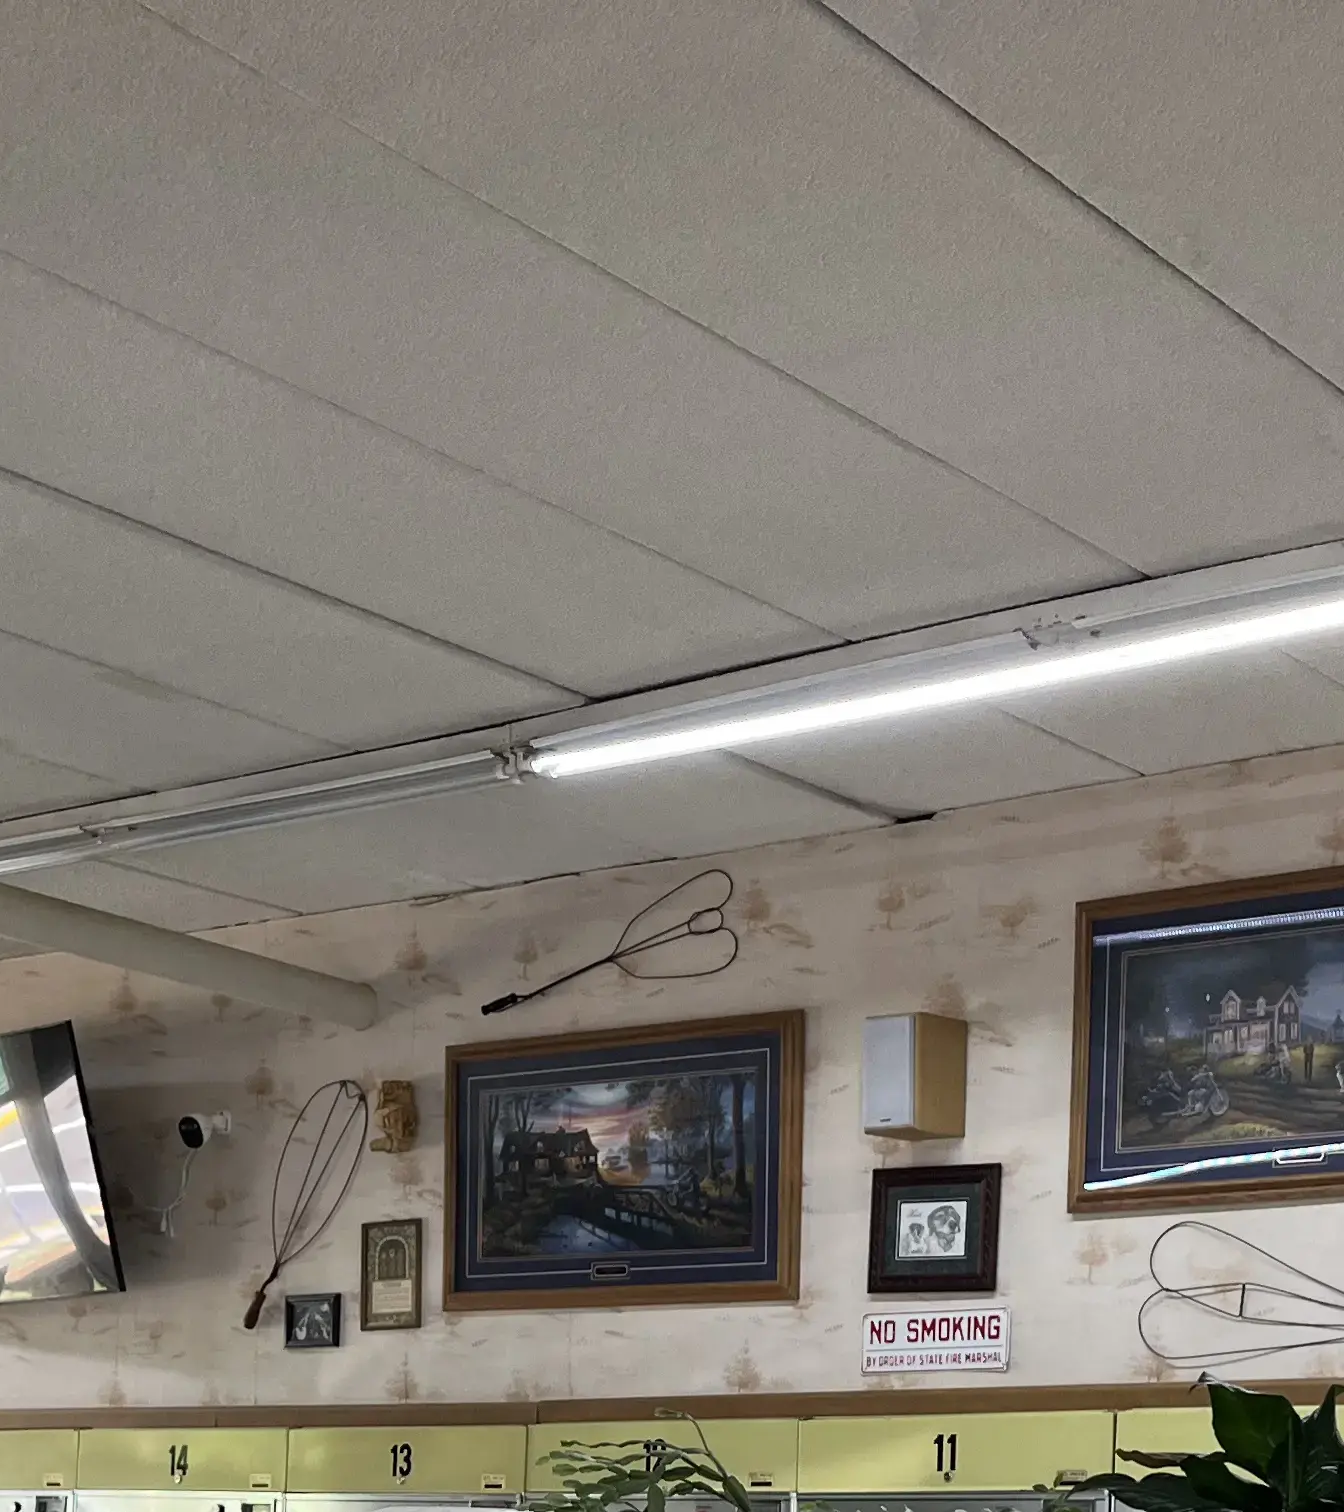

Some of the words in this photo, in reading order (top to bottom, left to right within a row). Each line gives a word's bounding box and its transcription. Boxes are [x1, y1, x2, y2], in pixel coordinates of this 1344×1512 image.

[869, 1320, 896, 1345] NO
[906, 1315, 1001, 1343] SMOKING
[866, 1356, 877, 1368] BY
[878, 1355, 904, 1367] ORDER
[906, 1354, 916, 1365] OF
[919, 1352, 943, 1365] STATE
[945, 1353, 962, 1364] FIRE
[965, 1351, 1001, 1364] MARSHAL
[168, 1444, 188, 1476] 14
[390, 1443, 412, 1477] 13
[933, 1434, 957, 1471] 11
